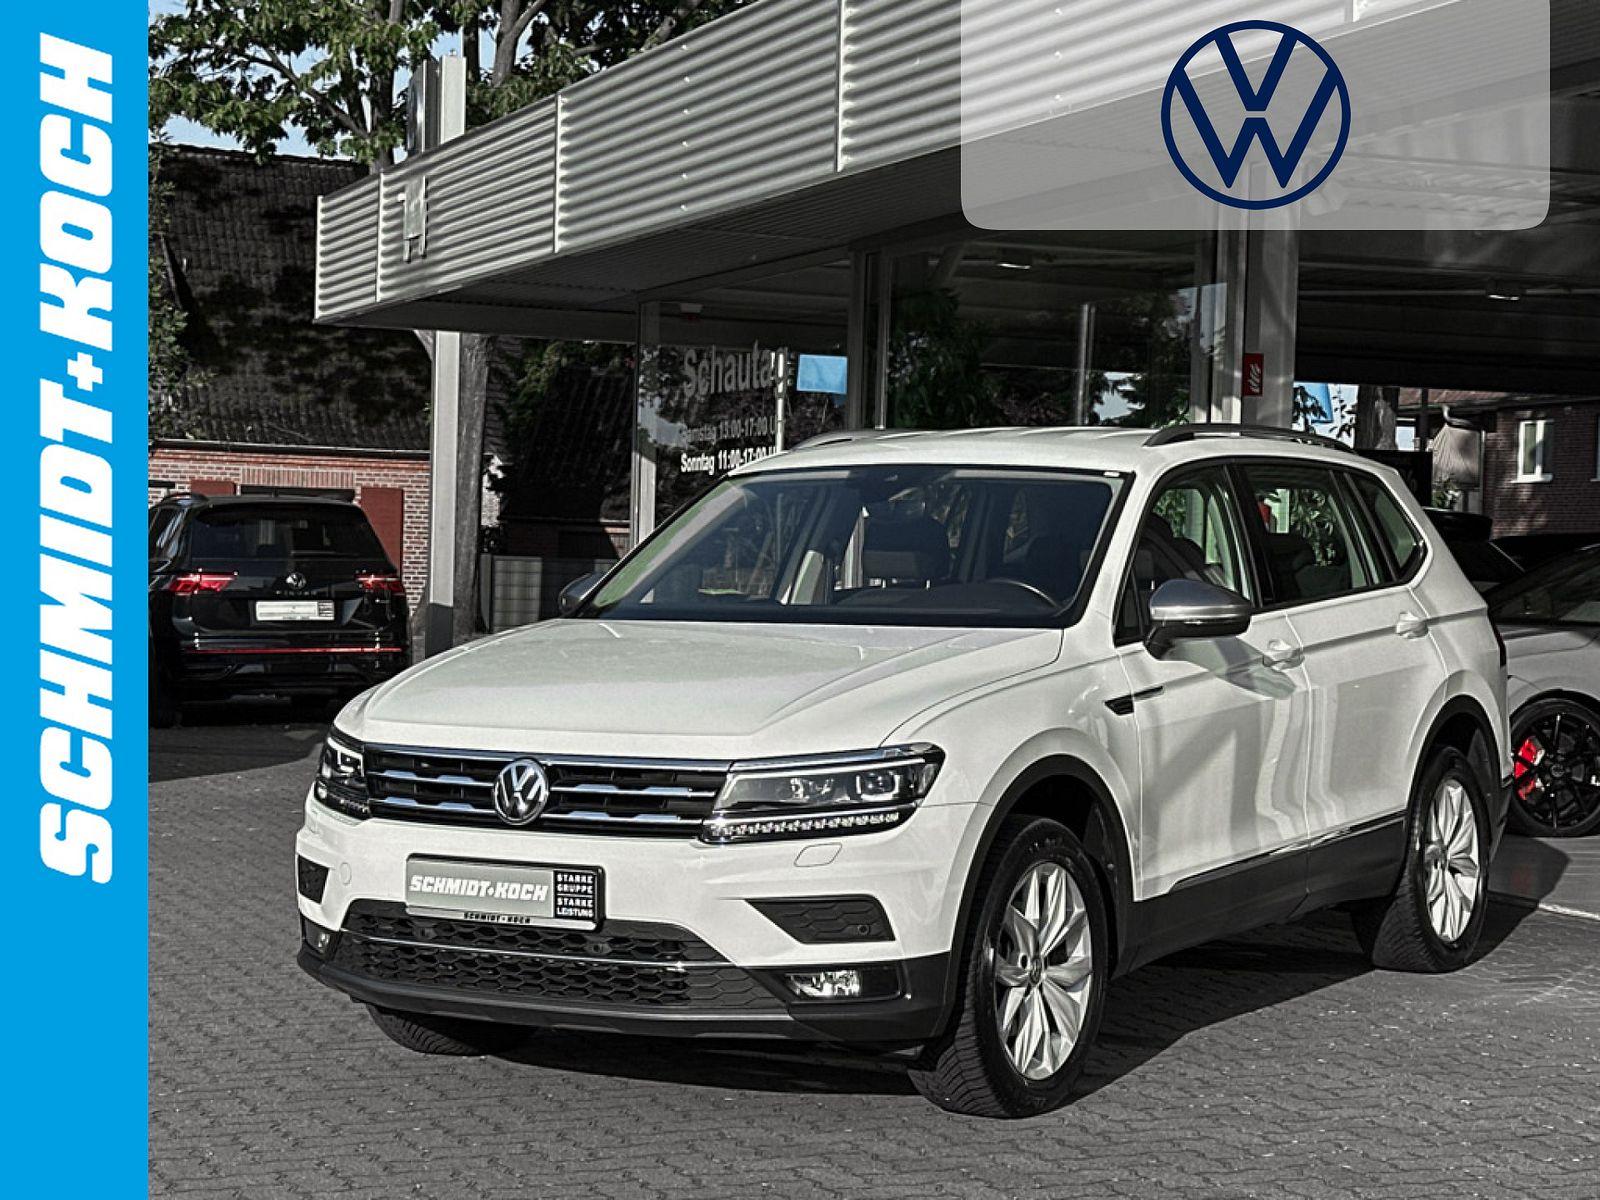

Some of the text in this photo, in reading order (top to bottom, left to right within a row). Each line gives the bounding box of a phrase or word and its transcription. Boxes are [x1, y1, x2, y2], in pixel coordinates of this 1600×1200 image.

[681, 452, 715, 475] Sonntag
[557, 873, 593, 884] STARKE
[557, 883, 593, 894] GRUPPE
[557, 897, 593, 908] STARKE
